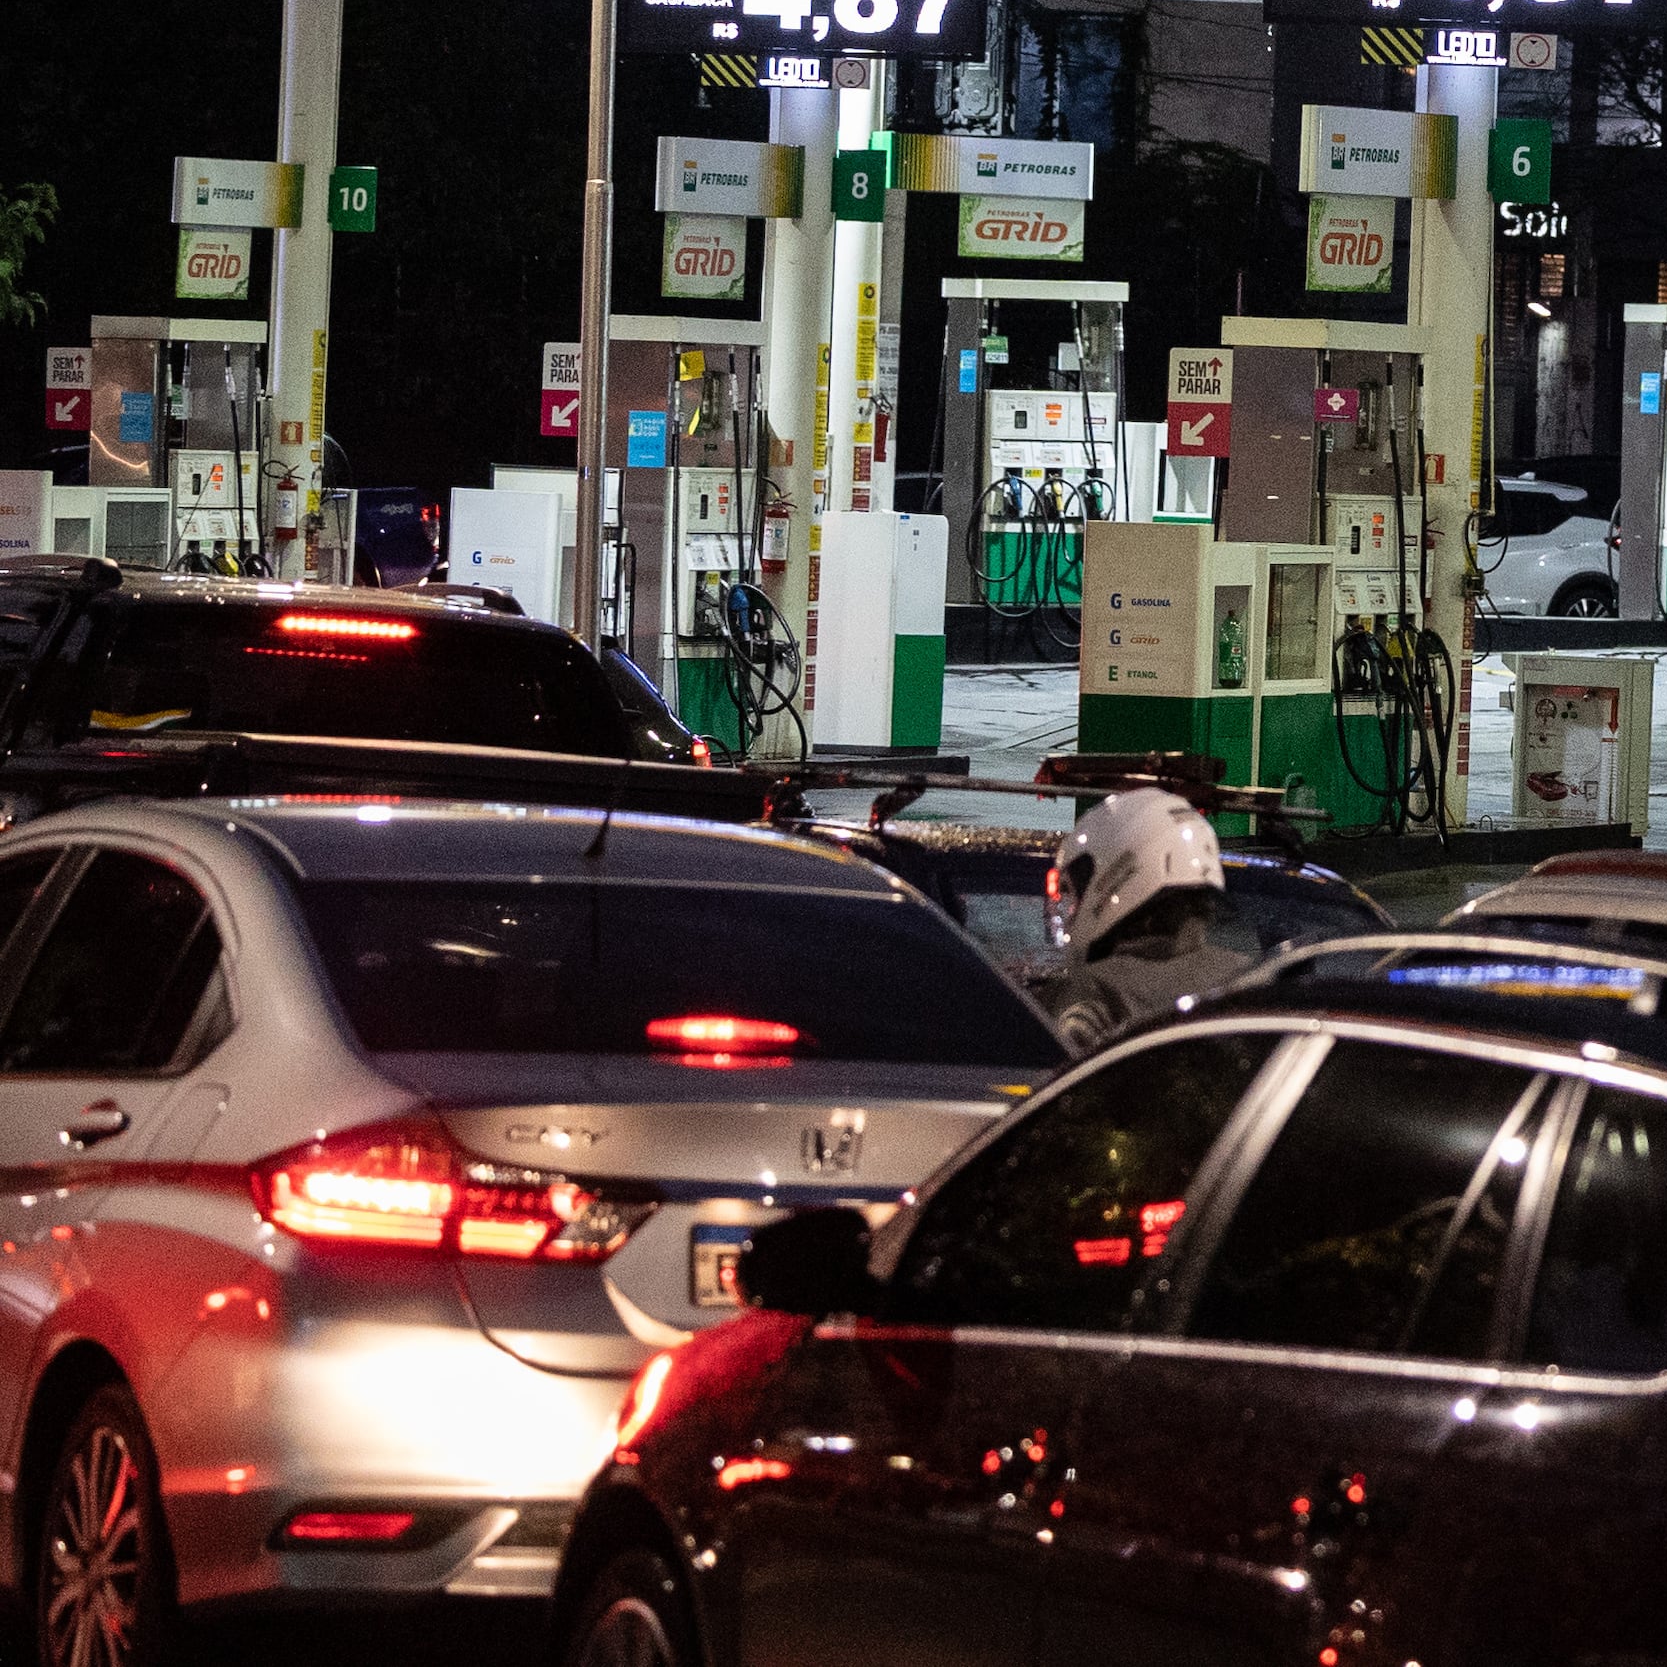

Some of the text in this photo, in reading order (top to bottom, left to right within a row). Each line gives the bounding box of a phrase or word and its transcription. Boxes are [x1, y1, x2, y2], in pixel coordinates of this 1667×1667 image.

[712, 22, 739, 39] R$
[1350, 147, 1400, 163] PETROBRAS
[1511, 146, 1531, 177] 6
[1004, 163, 1077, 176] PETROBRAS
[700, 172, 748, 186] PETROBRAS
[852, 172, 868, 199] 8
[211, 187, 254, 201] PETROBRAS
[338, 187, 368, 212] 10
[974, 218, 1068, 243] GRID
[1320, 232, 1384, 265] GRID
[187, 252, 242, 279] GRID
[674, 246, 736, 276] GRID
[53, 356, 74, 370] SEM
[551, 353, 575, 368] SEM
[1178, 360, 1207, 377] SEM
[52, 370, 84, 383] PARAR
[550, 368, 580, 383] PARA
[1177, 378, 1221, 395] PARAR
[0, 539, 30, 549] SOLINA
[472, 550, 482, 565] G
[1110, 593, 1171, 610] G GASOLINA
[1109, 629, 1160, 645] G GRID
[1108, 665, 1158, 682] E ETANOL
